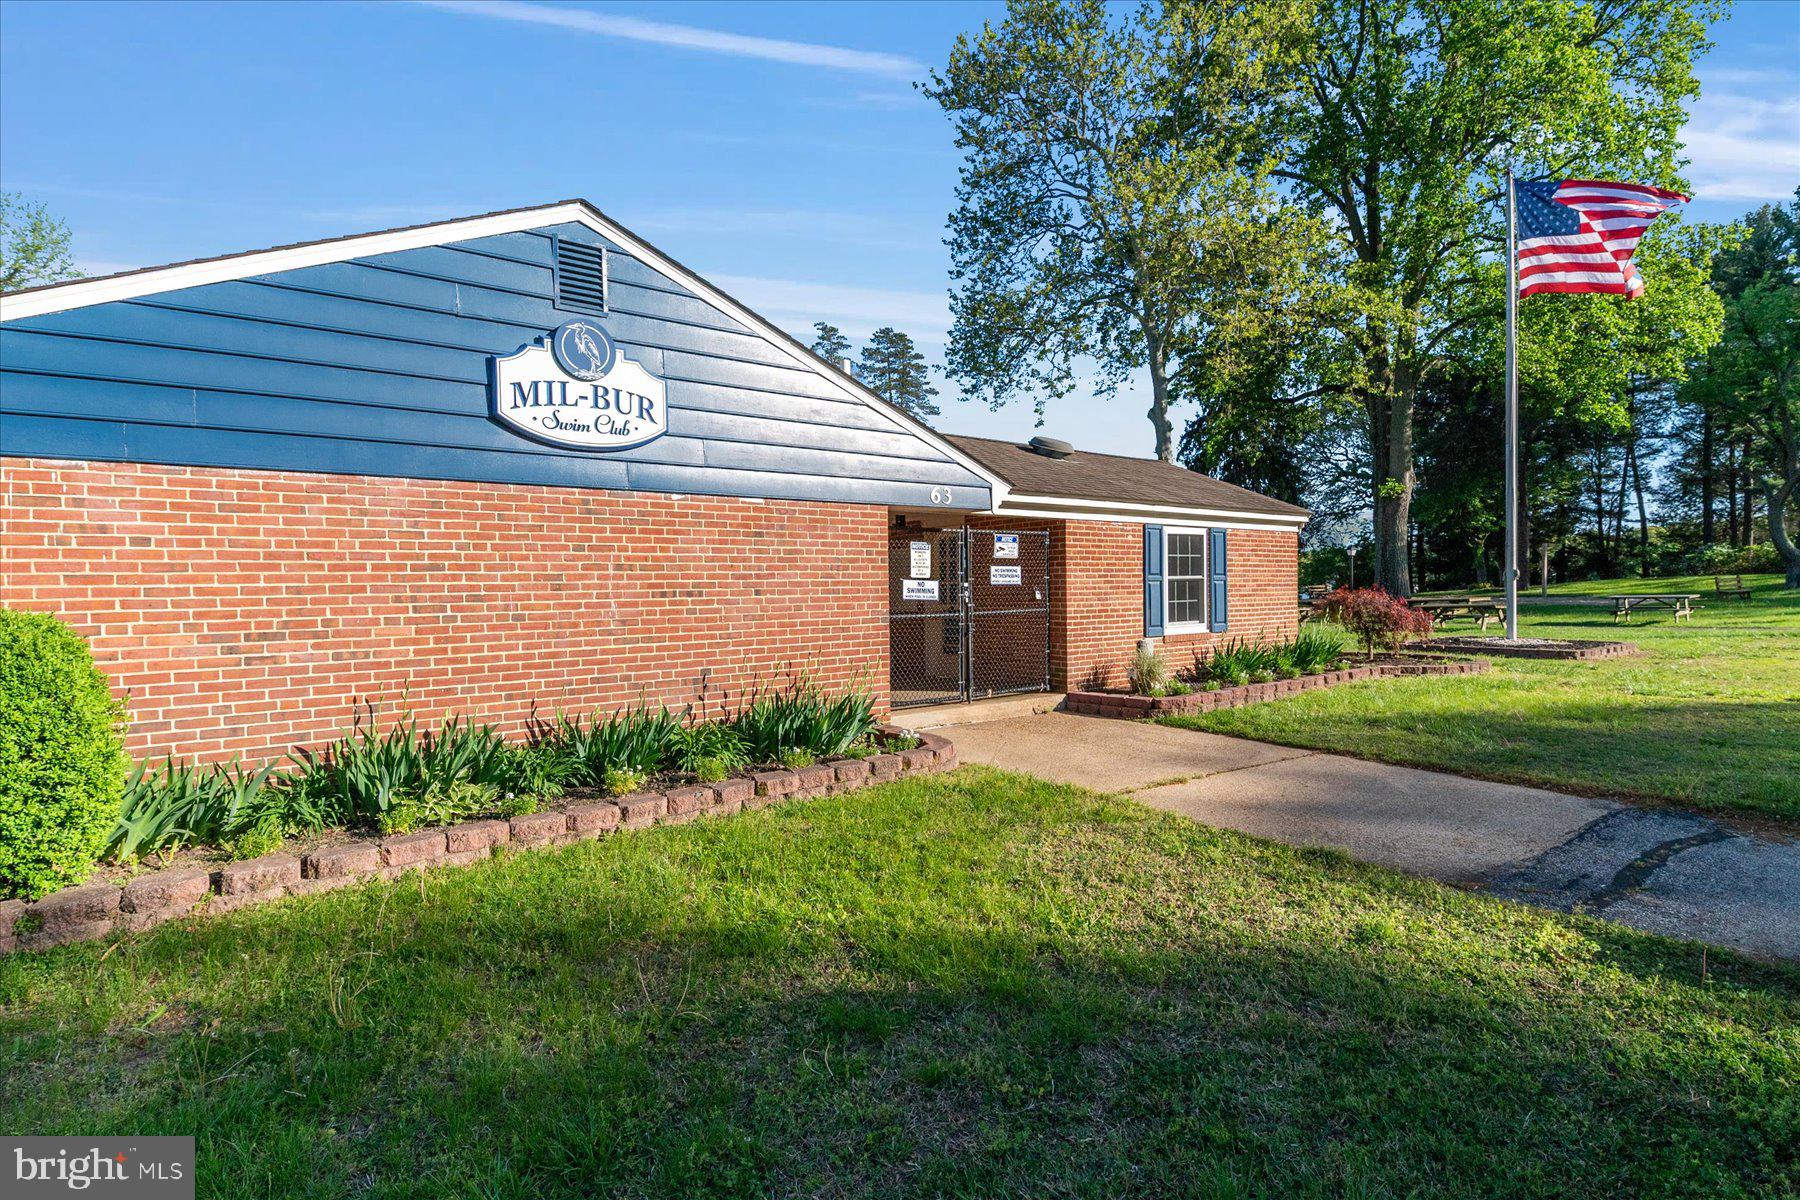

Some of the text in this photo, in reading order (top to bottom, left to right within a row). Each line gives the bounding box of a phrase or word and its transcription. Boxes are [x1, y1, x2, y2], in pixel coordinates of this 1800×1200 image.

[510, 380, 658, 425] MIL-BUR
[541, 409, 631, 436] Swim Club
[930, 486, 952, 505] 63
